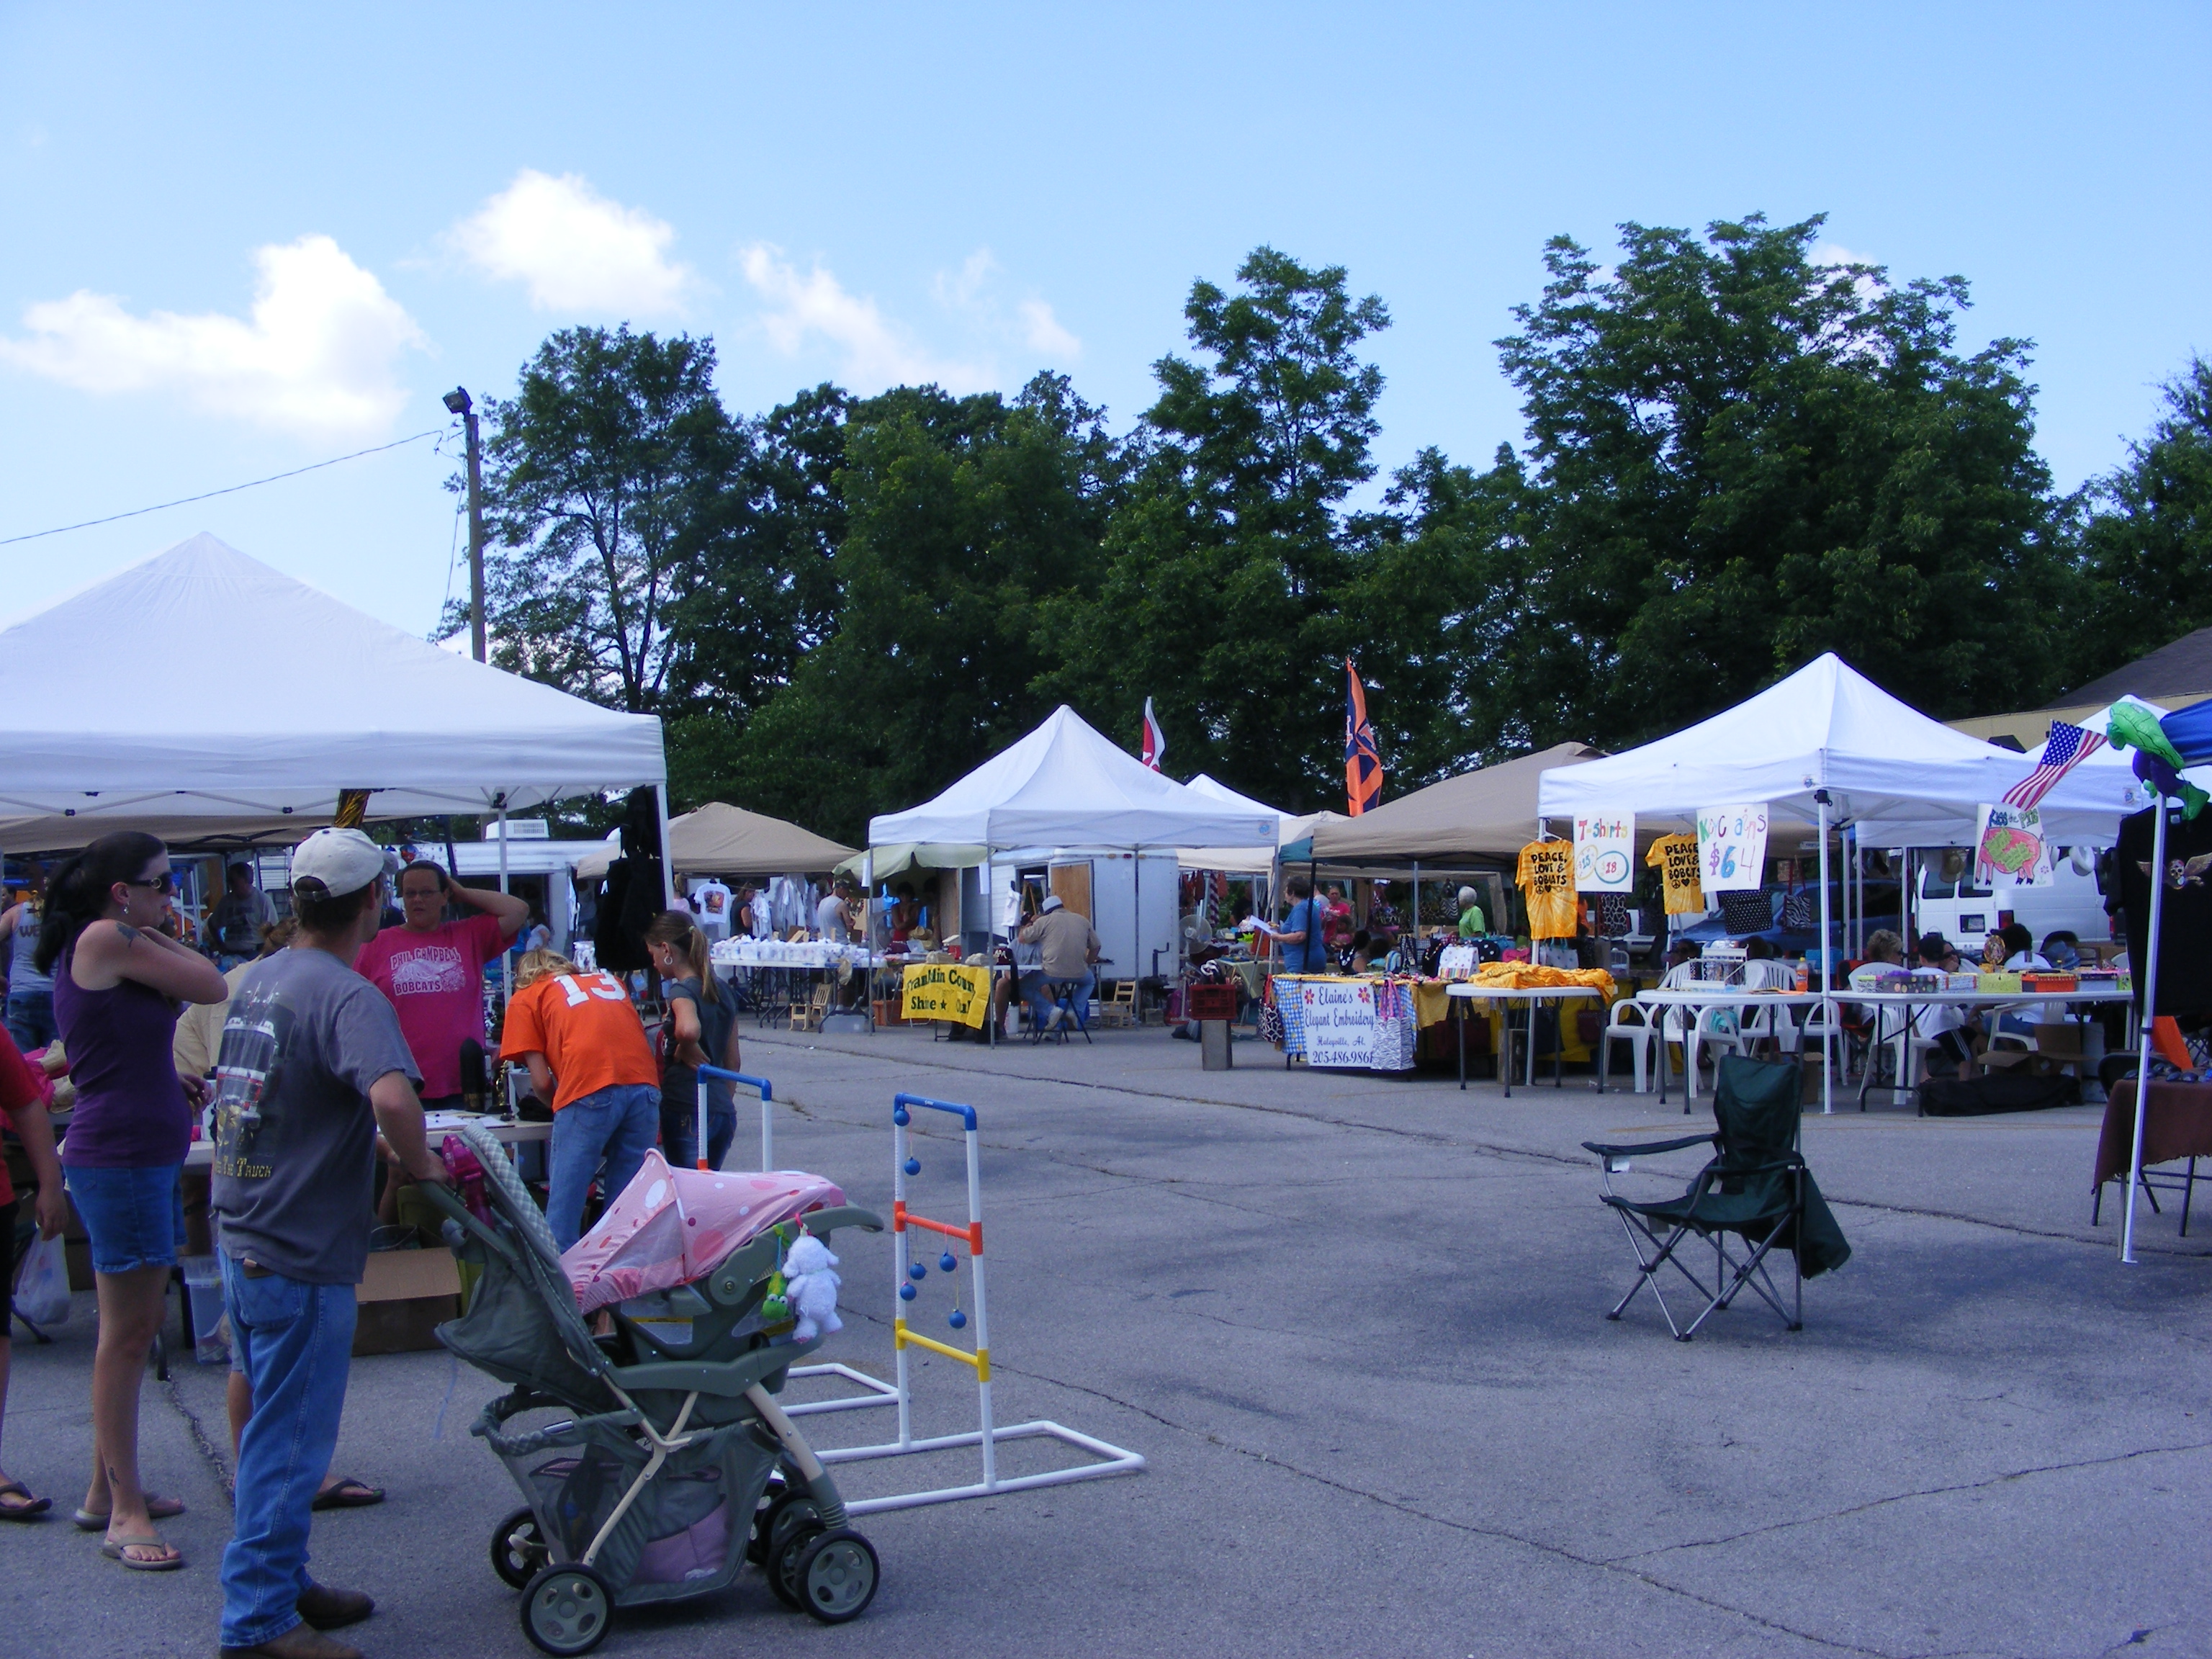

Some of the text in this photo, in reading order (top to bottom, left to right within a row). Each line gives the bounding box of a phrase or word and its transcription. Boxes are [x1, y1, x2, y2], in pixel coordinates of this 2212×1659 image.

[2018, 808, 2039, 829] PIG
[1531, 852, 1568, 863] PEACE,
[1668, 855, 1691, 868] LOVE
[1534, 863, 1565, 874] LOVE &
[1668, 866, 1700, 880] BOBCTS
[390, 945, 462, 970] PHIL CAMPBELL
[394, 981, 444, 996] BOBCATS
[553, 968, 626, 1007] 13
[1318, 986, 1354, 1005] Elaine's
[1305, 1007, 1375, 1031] Elegant Embroidery
